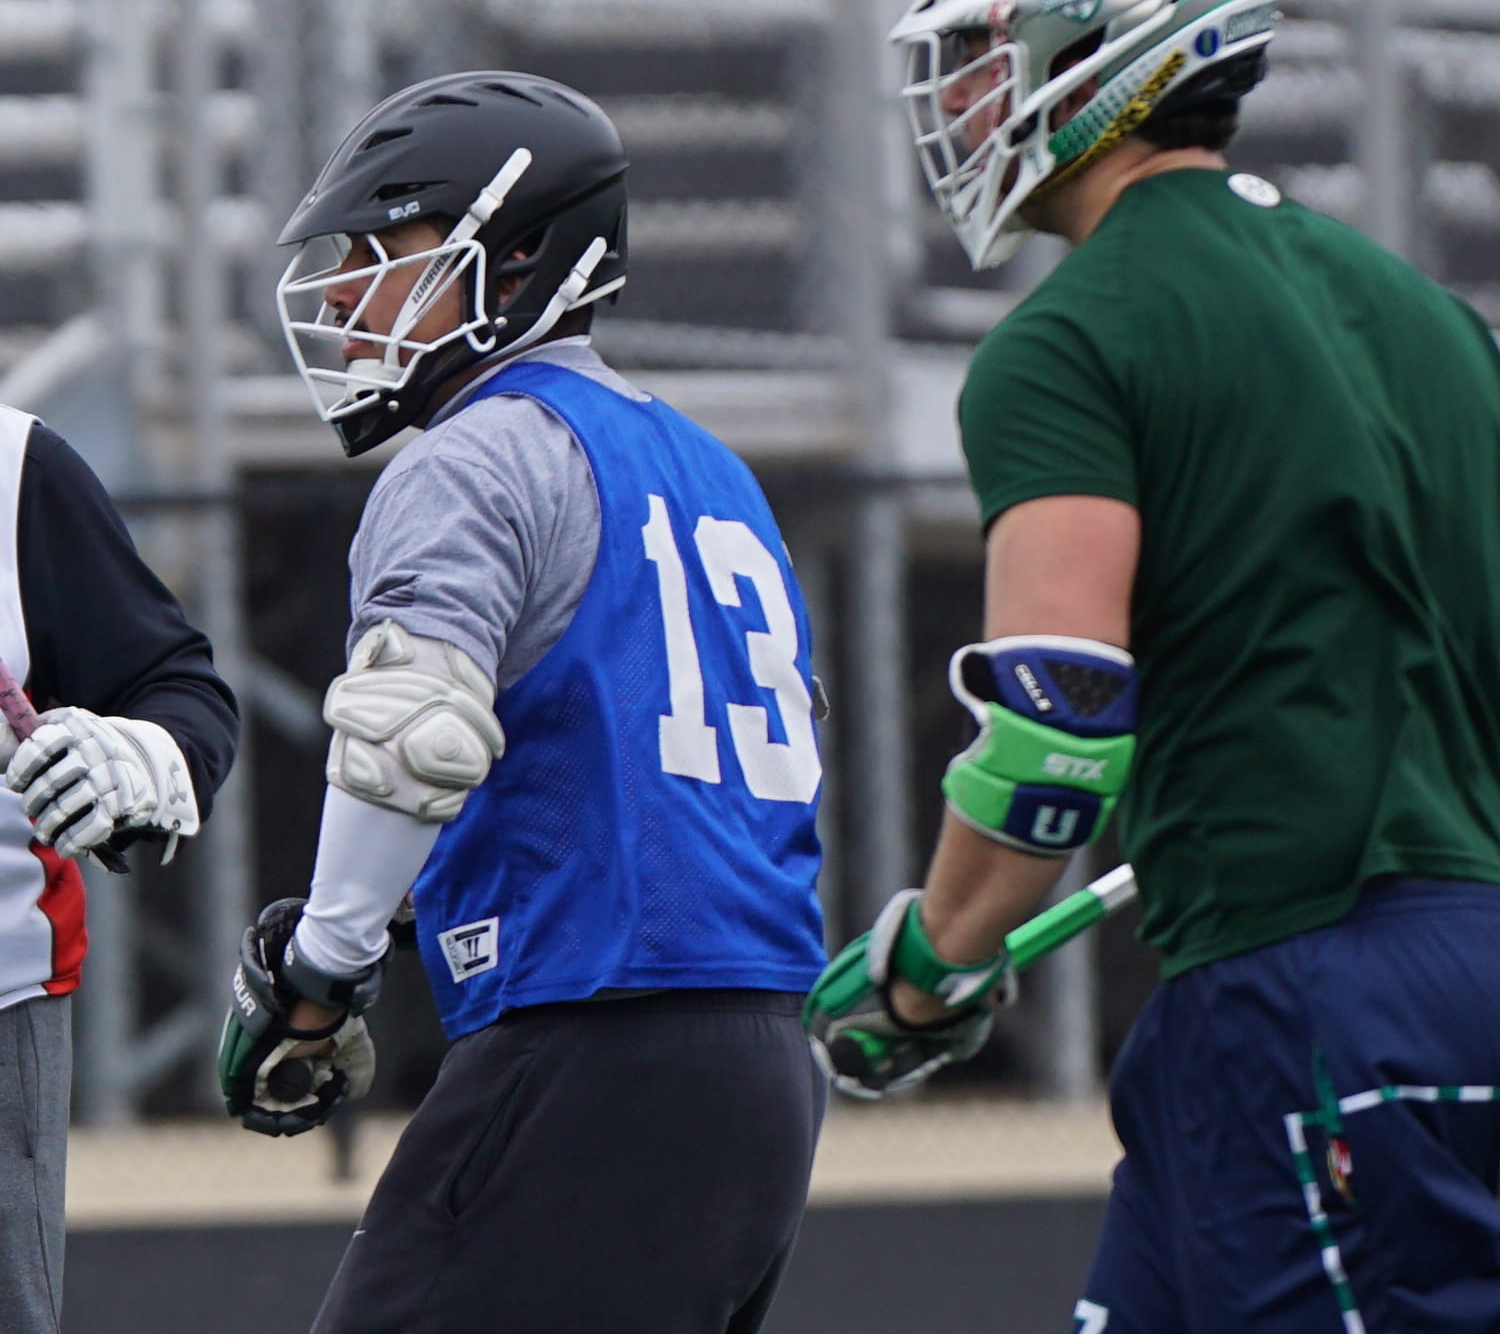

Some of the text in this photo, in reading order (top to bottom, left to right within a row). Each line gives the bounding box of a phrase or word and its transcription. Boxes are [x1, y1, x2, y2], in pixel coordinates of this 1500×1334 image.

[388, 200, 421, 221] EVO
[641, 493, 822, 804] 13
[1043, 752, 1109, 780] STX
